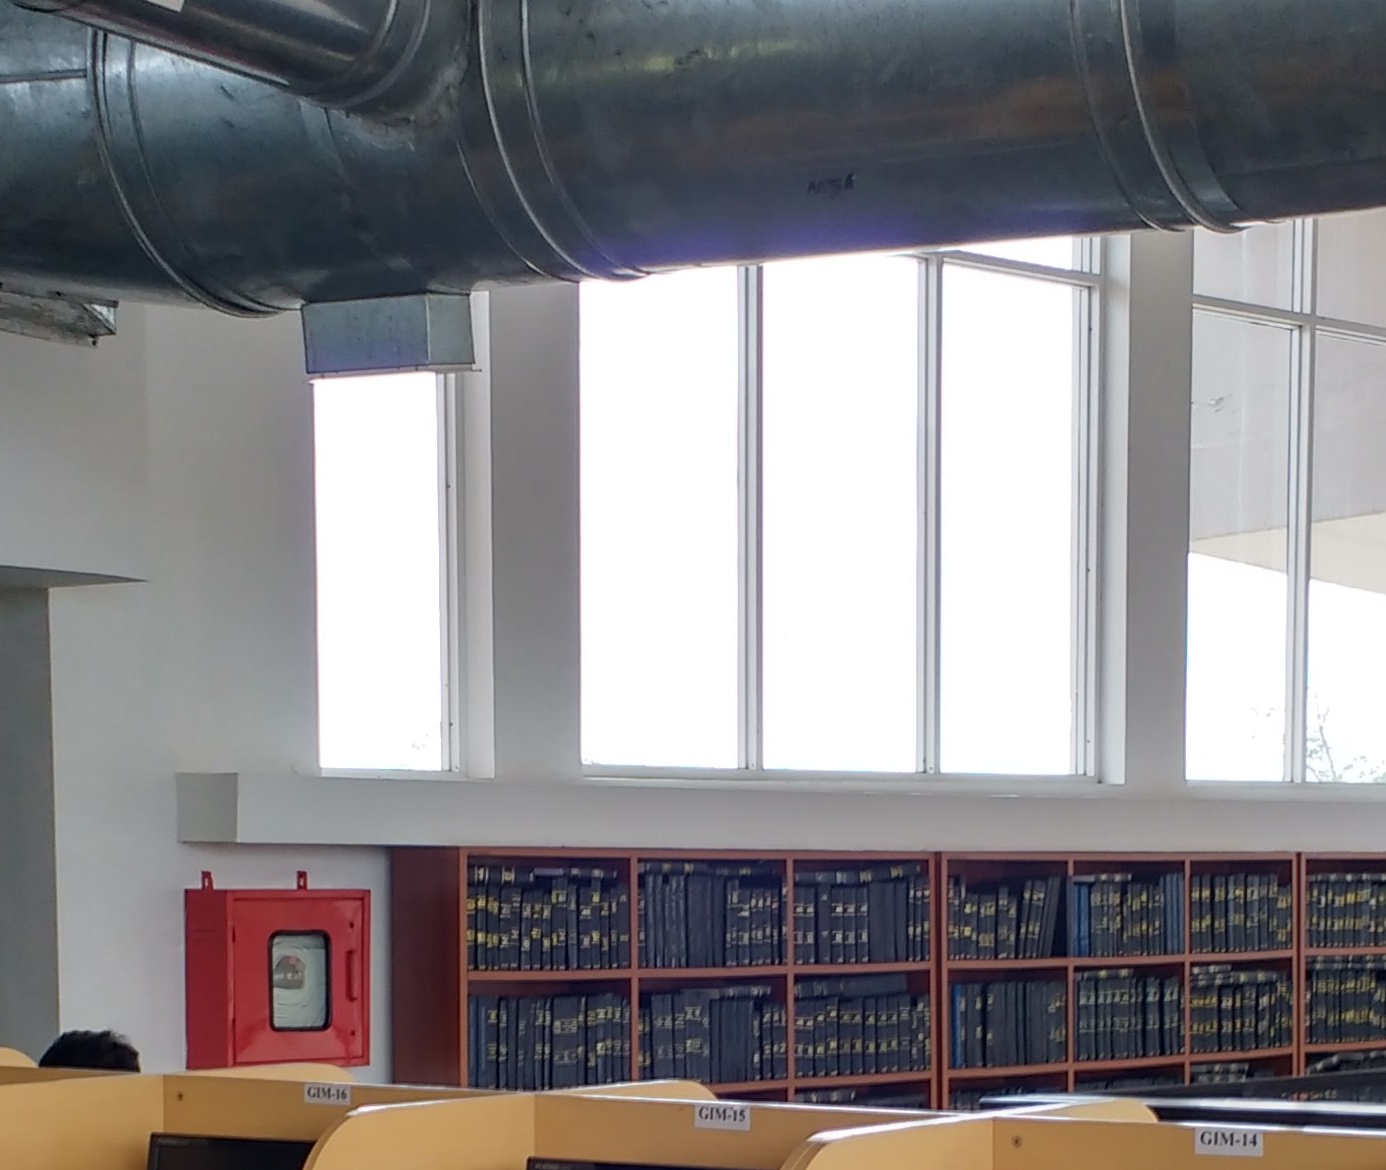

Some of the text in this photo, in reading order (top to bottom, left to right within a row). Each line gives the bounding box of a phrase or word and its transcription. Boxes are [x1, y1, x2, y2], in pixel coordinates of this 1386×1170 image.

[307, 1086, 348, 1100] GIM-16
[698, 1106, 746, 1122] GIM-15
[1199, 1130, 1258, 1148] GIM-14
